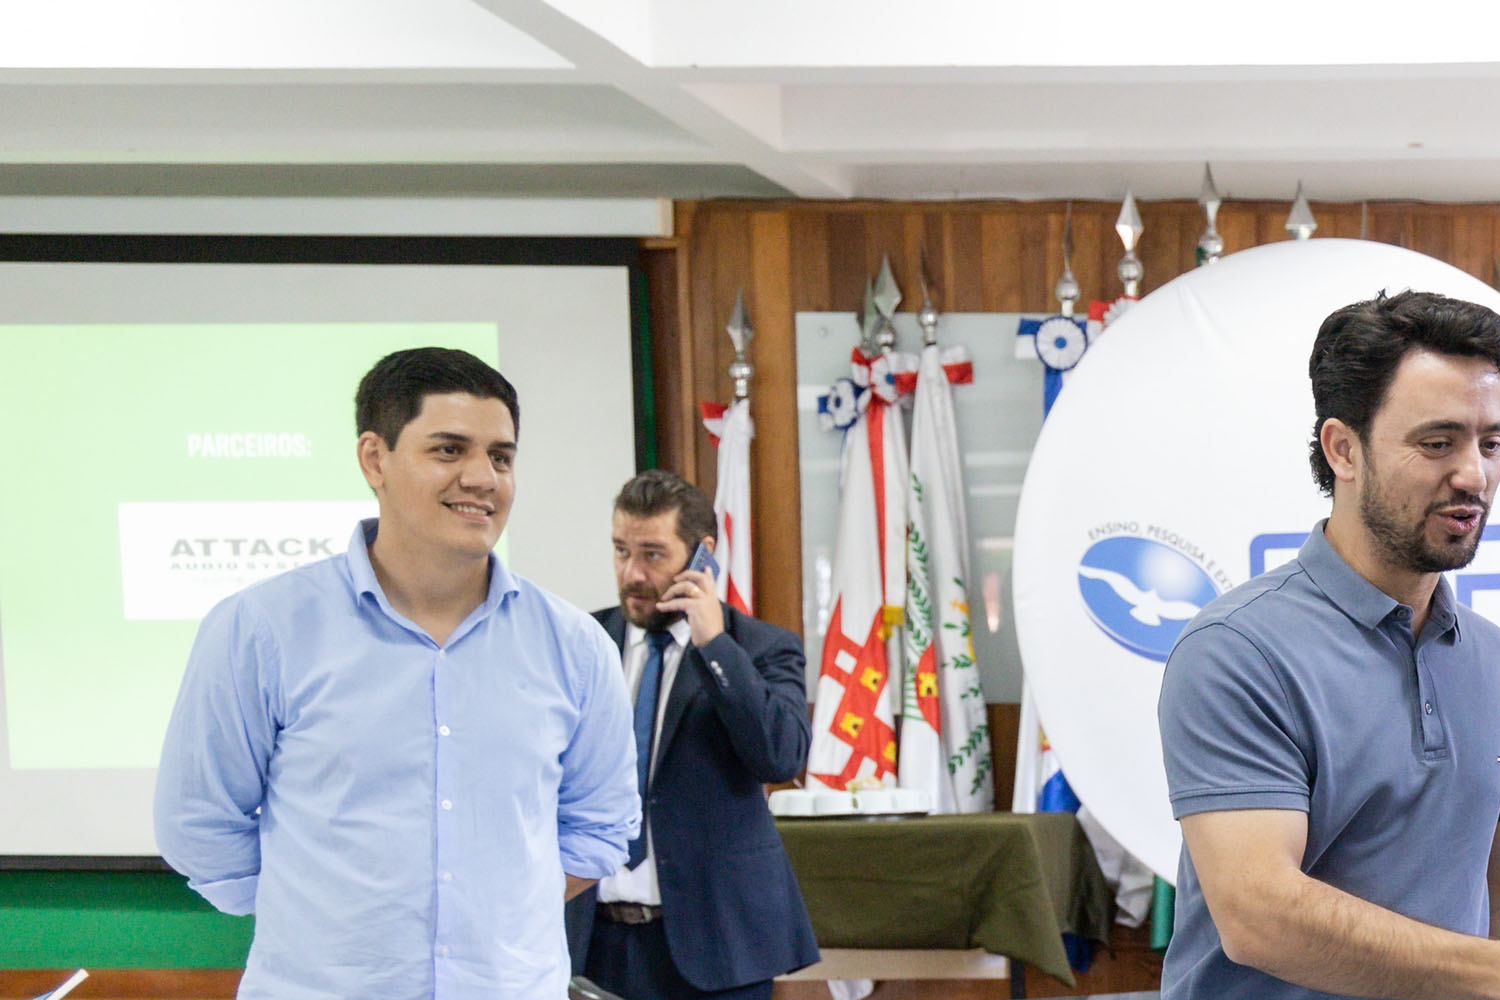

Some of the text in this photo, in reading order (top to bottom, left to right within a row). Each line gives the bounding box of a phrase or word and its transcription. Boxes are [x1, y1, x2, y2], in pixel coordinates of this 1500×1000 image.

[186, 432, 312, 457] PARCEIROS:
[170, 538, 334, 557] ATTACK
[1148, 525, 1204, 563] PESQUISA
